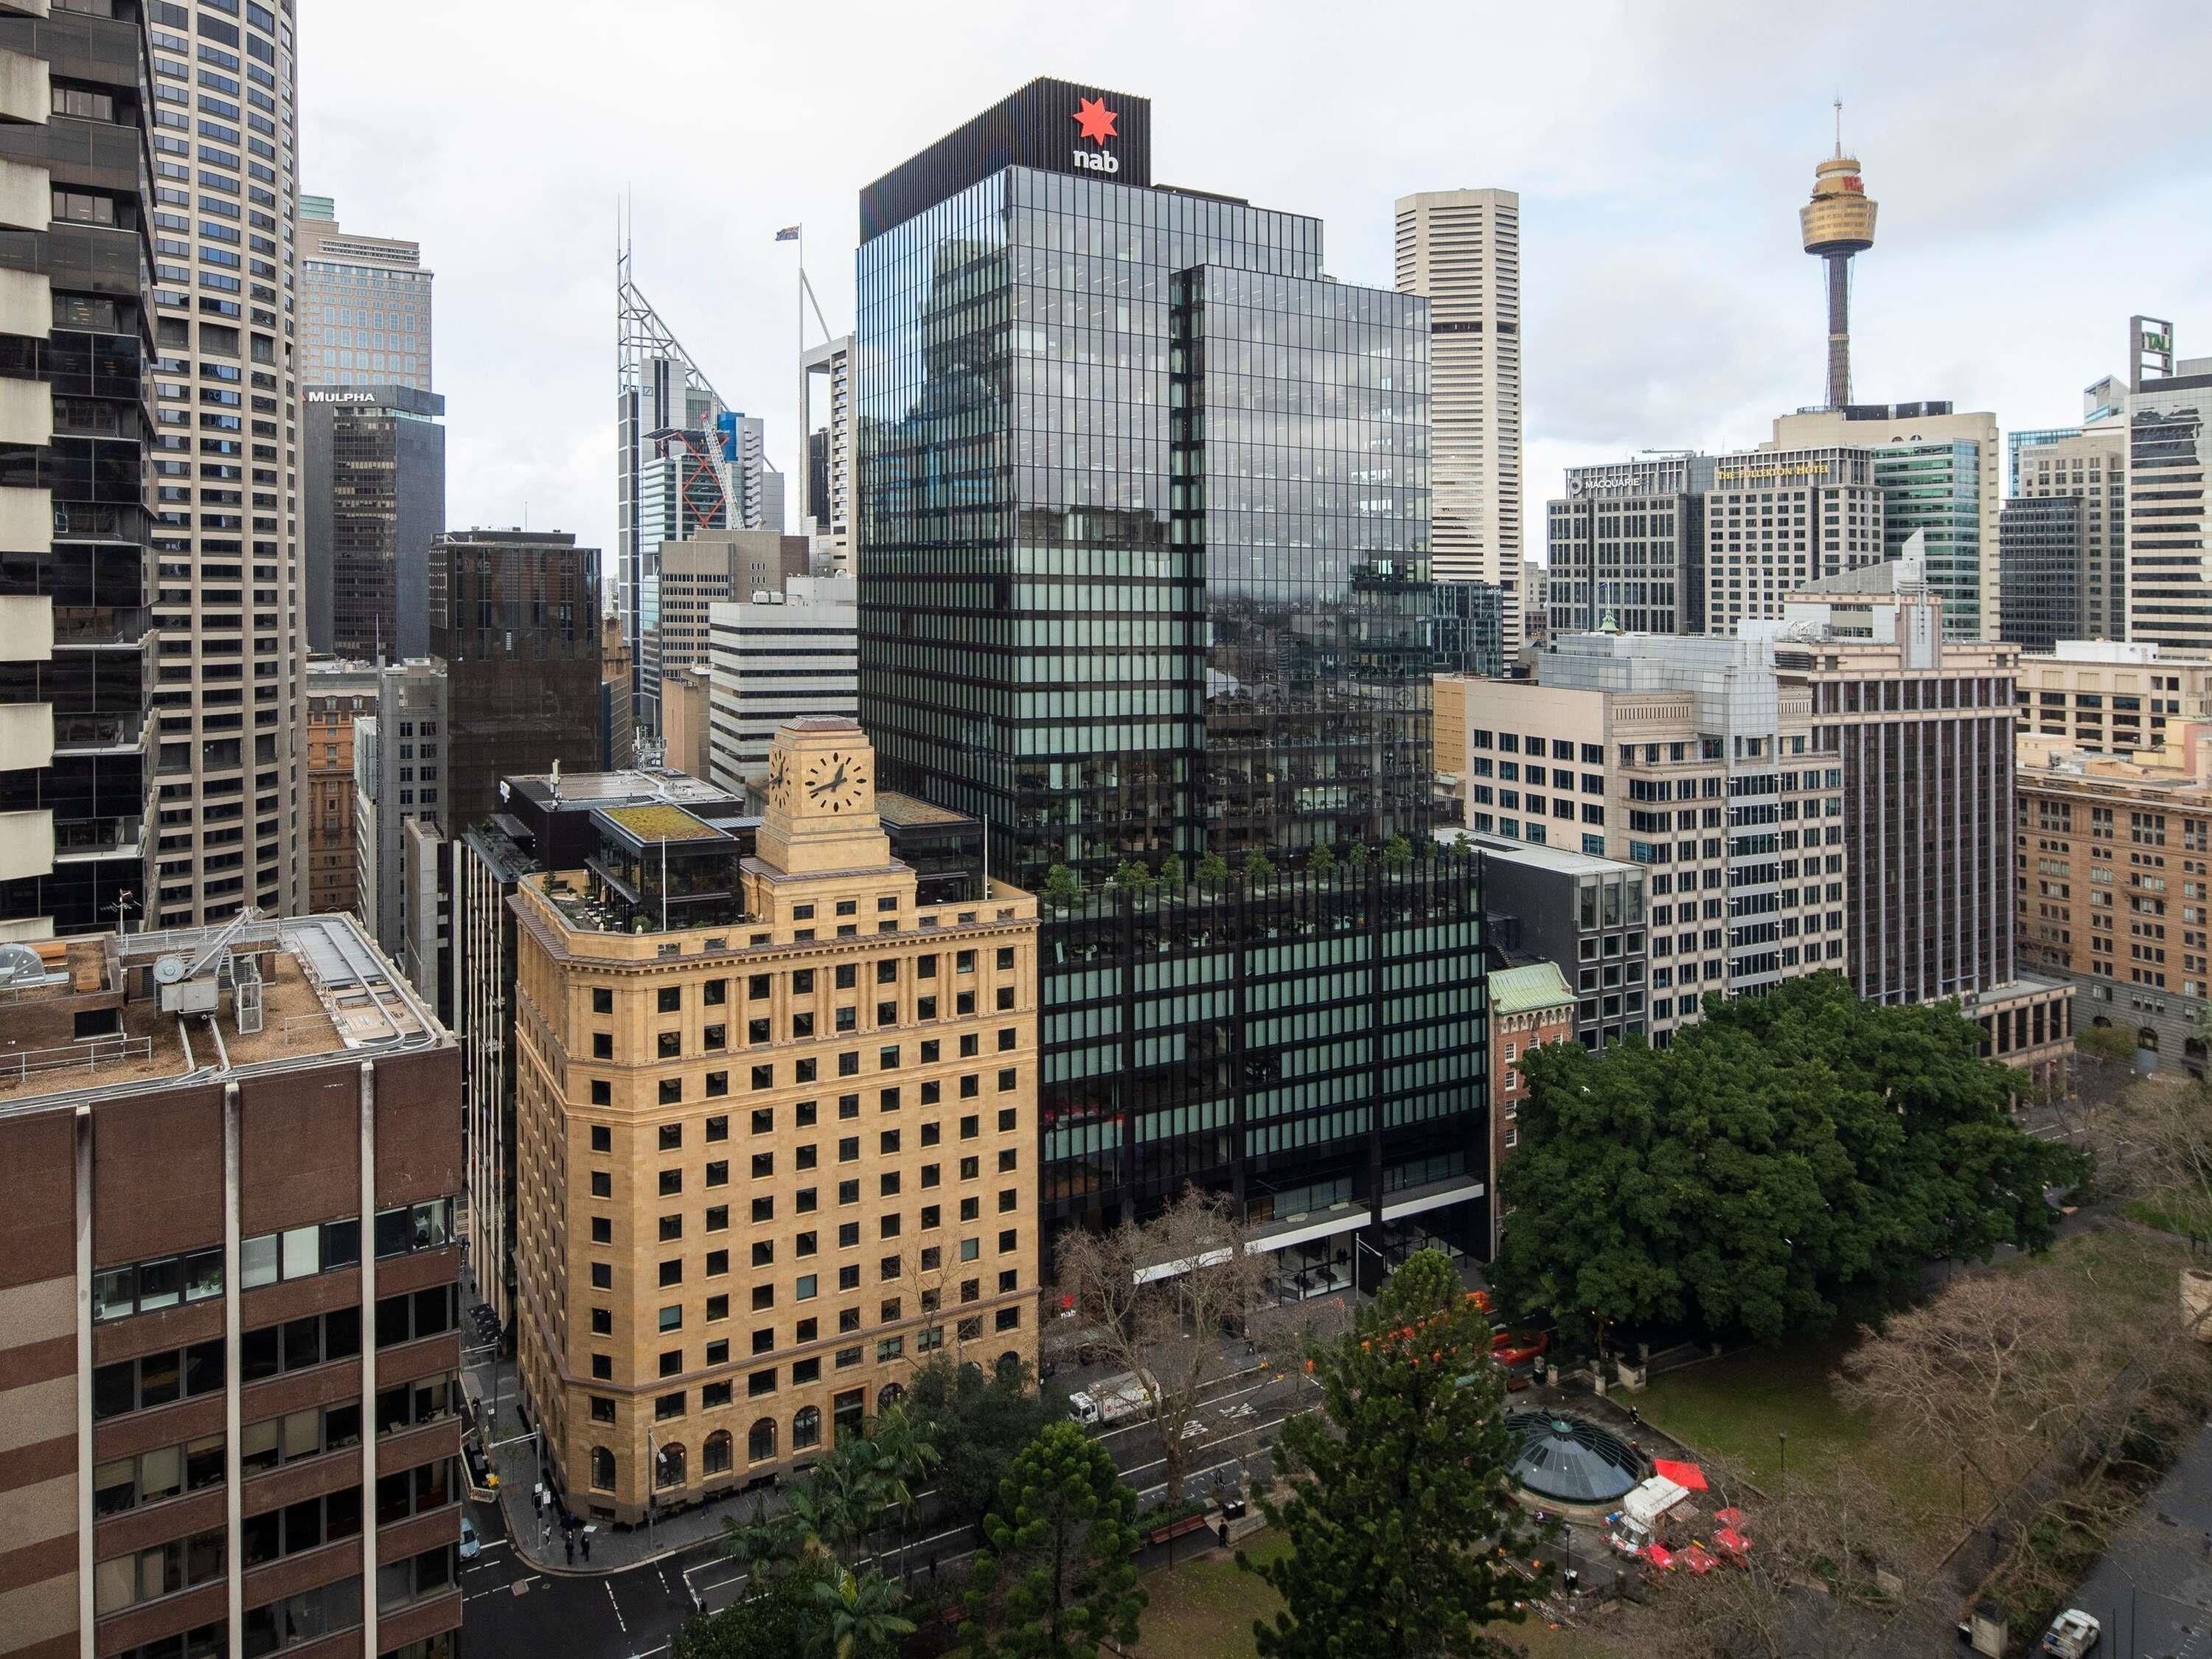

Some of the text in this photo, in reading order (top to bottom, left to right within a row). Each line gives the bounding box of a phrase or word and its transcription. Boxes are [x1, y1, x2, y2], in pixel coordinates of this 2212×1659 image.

[1073, 150, 1119, 173] nab
[2146, 332, 2170, 352] TAL
[309, 392, 375, 402] MULPHA
[1718, 465, 1829, 479] THE FULLERTON HOTEL
[1585, 478, 1641, 489] MACQUARIE
[1060, 1309, 1077, 1320] nab
